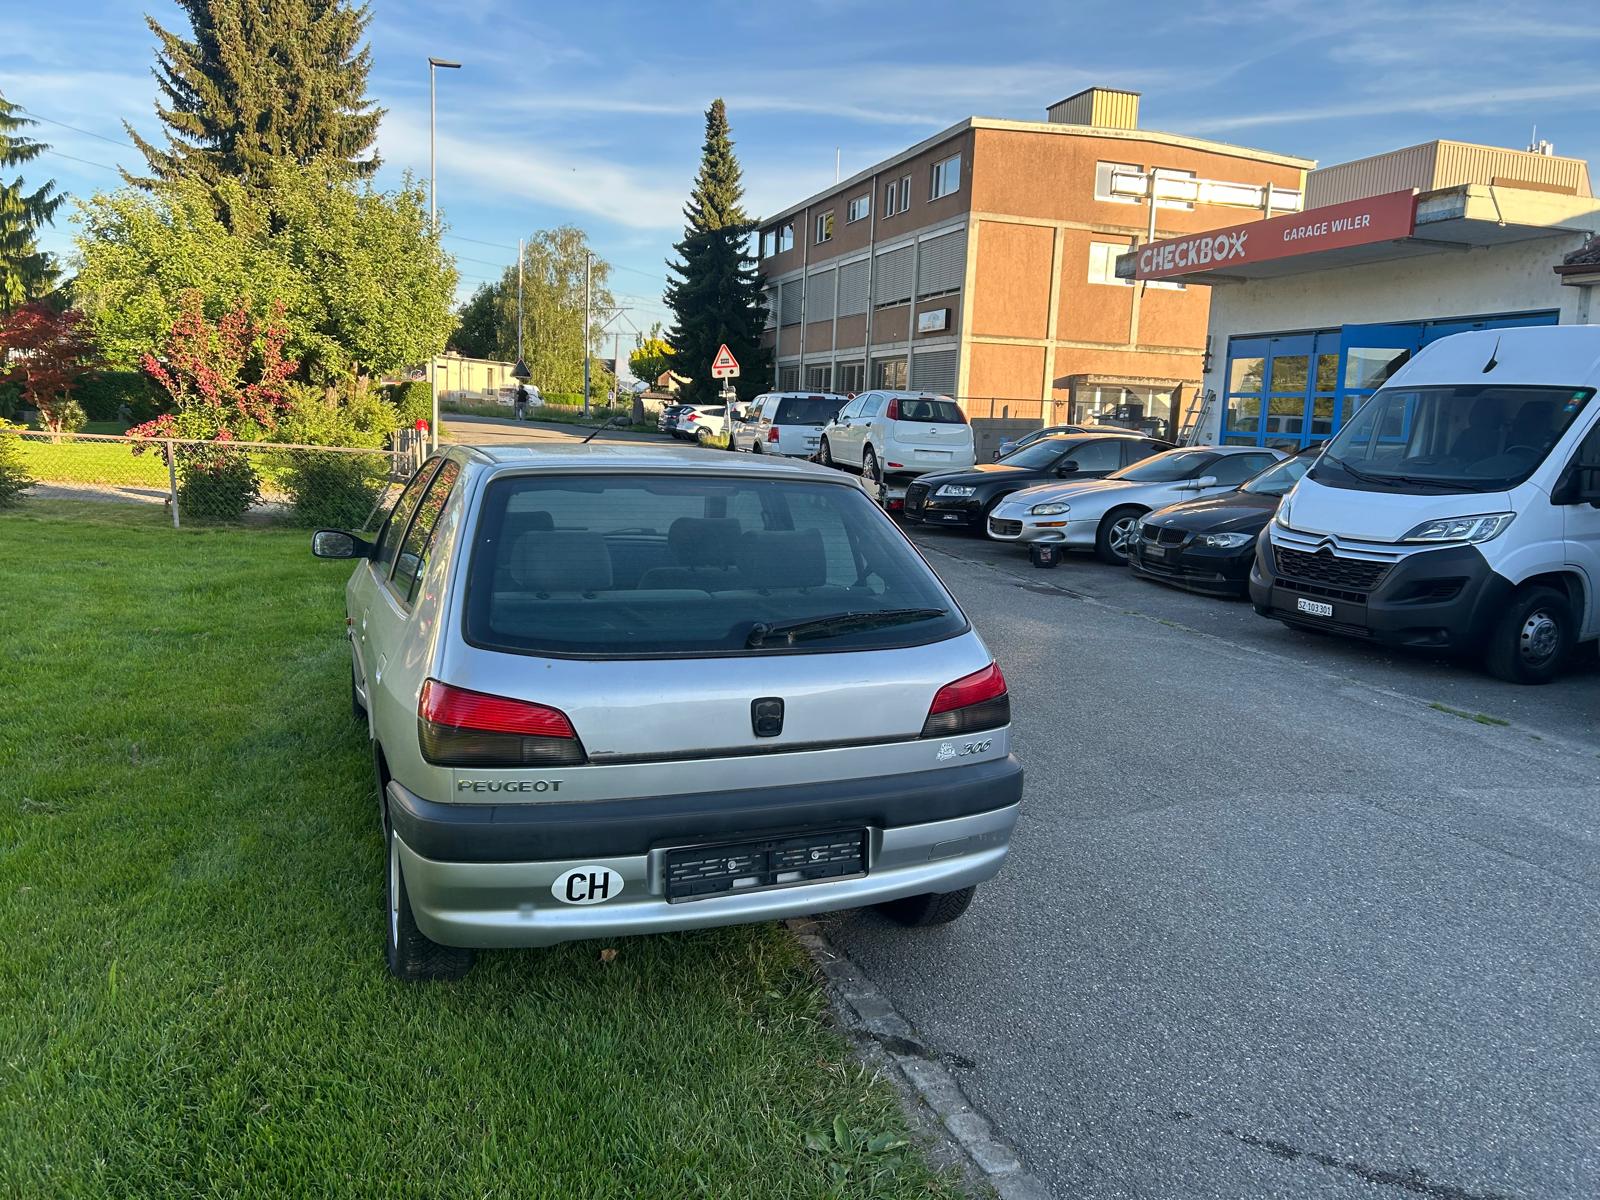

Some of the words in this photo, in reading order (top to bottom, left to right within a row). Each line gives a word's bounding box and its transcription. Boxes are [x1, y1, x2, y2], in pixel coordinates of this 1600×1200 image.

[1283, 222, 1328, 241] GARAGE
[1331, 214, 1370, 232] WILER
[1140, 230, 1248, 273] CHECKBOX
[959, 738, 992, 756] 306
[457, 779, 563, 792] PEUGEOT
[565, 872, 609, 901] CH
